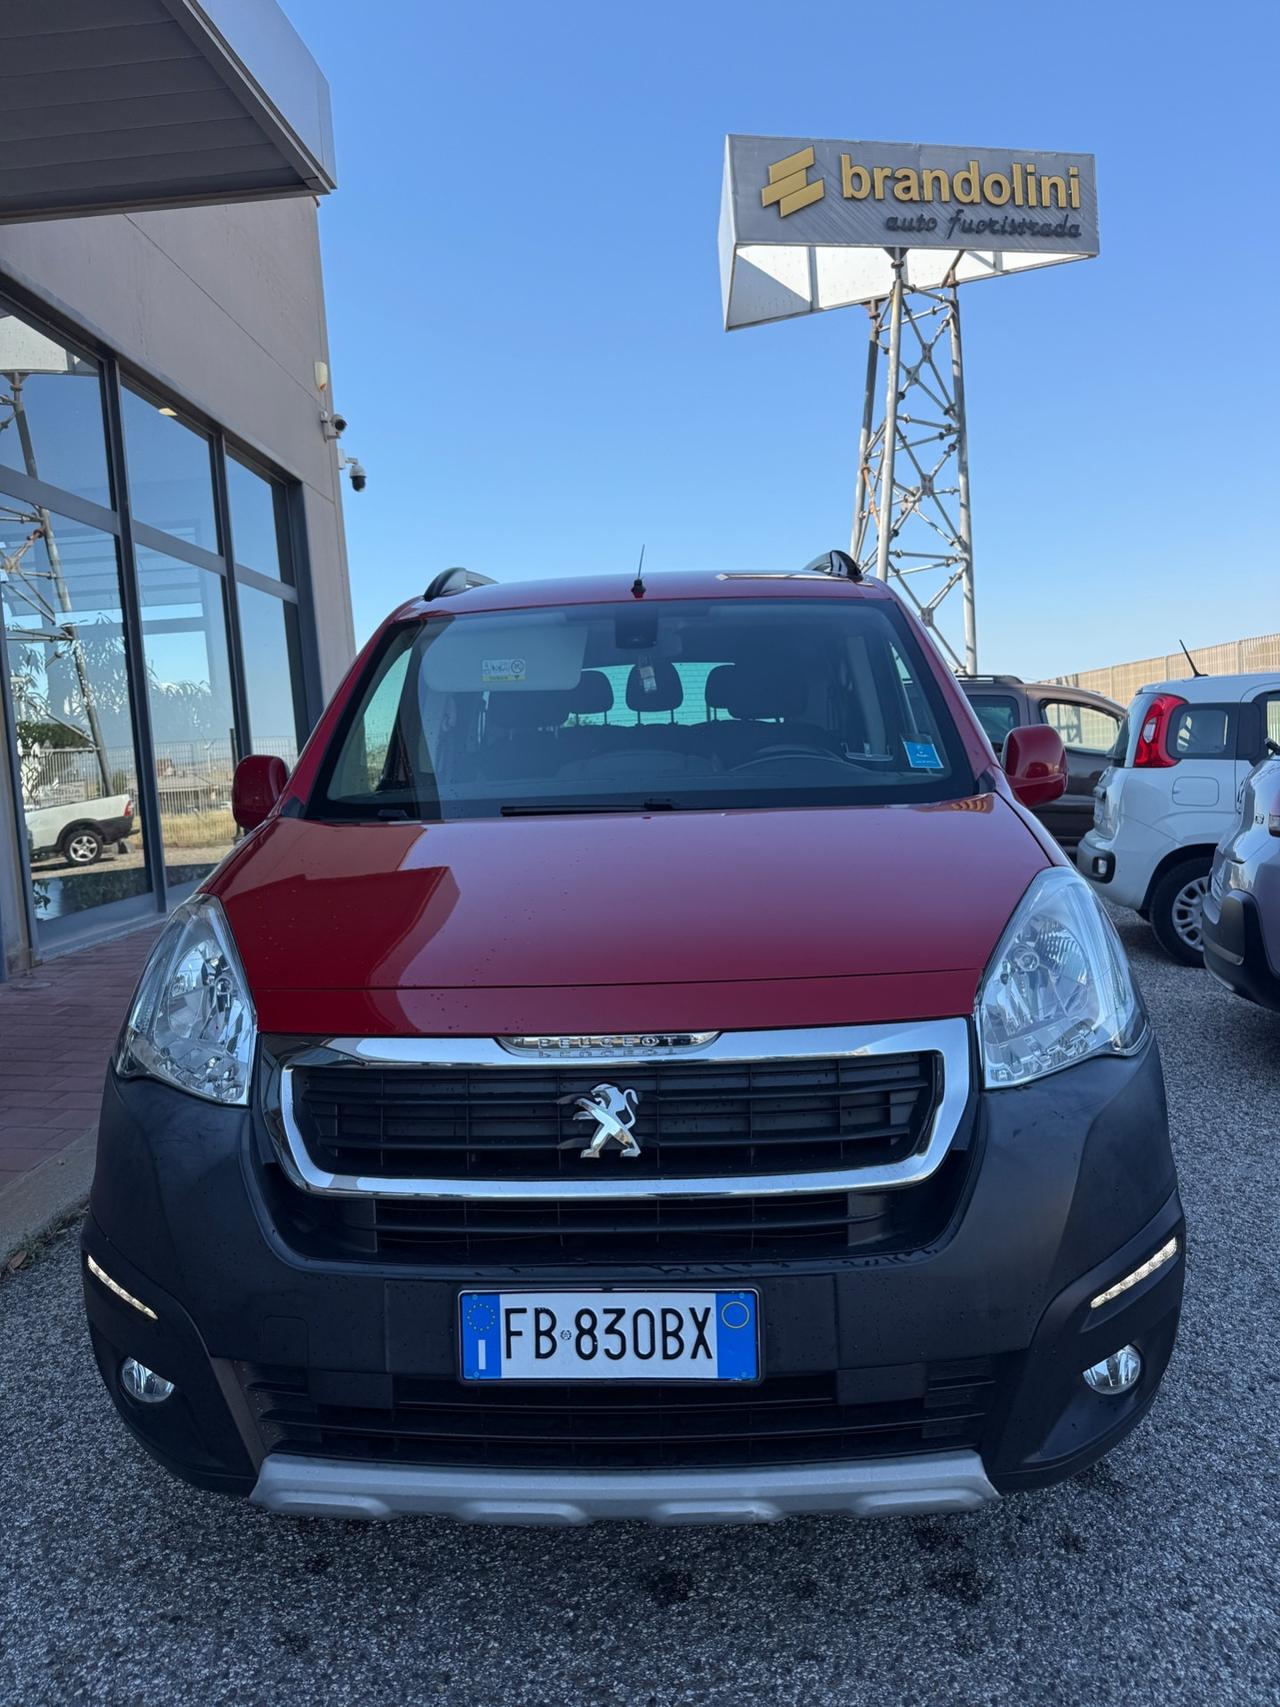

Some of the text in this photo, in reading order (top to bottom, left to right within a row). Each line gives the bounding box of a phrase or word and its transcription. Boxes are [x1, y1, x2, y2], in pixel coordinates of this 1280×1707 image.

[840, 153, 1081, 208] brandolini
[885, 208, 1082, 239] auto fuoristrada
[537, 1035, 675, 1048] PEUGEOT
